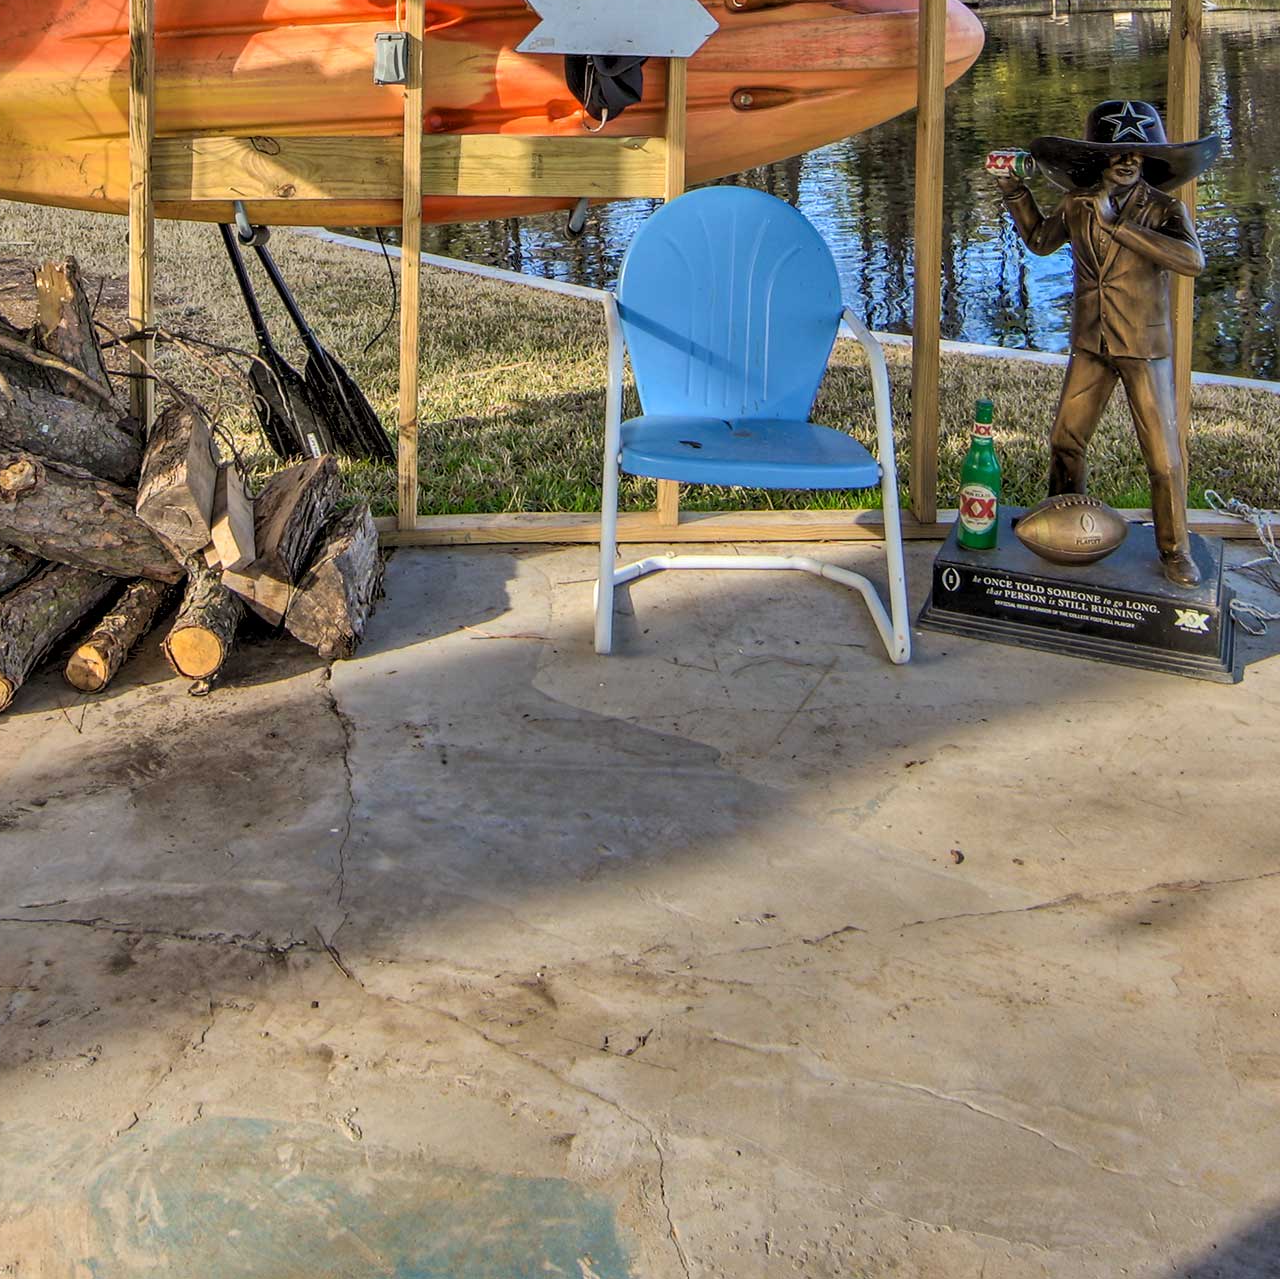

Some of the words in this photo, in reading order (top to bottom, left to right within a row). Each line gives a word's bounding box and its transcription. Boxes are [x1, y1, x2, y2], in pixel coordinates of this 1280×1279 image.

[983, 577, 1013, 589] ONCE
[1014, 582, 1045, 594] TOLD
[1046, 587, 1101, 603] SOMEONE
[1113, 600, 1123, 608] go
[1125, 601, 1161, 614] LONG.
[986, 587, 1003, 596] that
[1004, 590, 1046, 604] PERSON
[1048, 597, 1056, 605] is
[1057, 599, 1089, 611] STILL
[1091, 605, 1145, 621] RUNNING.
